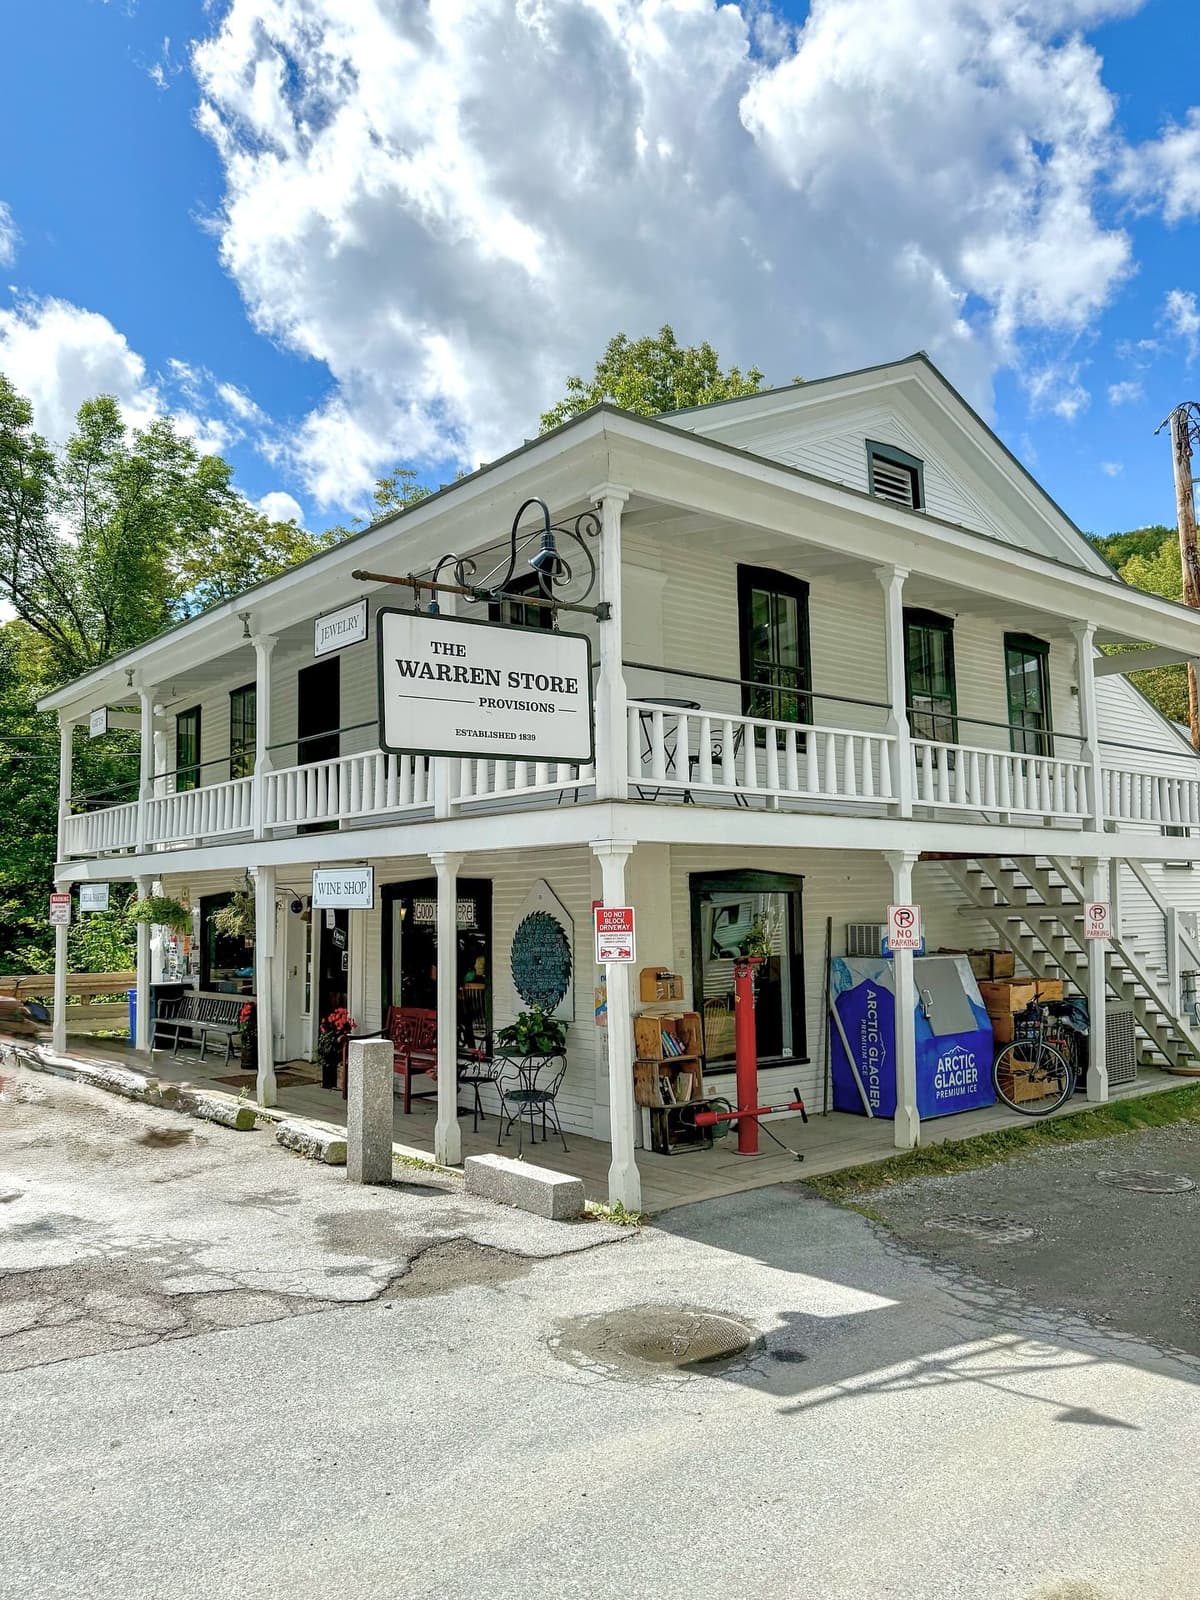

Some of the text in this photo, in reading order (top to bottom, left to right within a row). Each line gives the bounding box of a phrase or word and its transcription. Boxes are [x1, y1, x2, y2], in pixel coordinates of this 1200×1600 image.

[320, 614, 360, 645] JEWELRY
[430, 640, 467, 658] THE
[395, 659, 502, 687] WARREN
[507, 671, 578, 694] STORE
[479, 697, 555, 713] PROVISIONS
[455, 728, 536, 742] ESTABLISHED 1839
[318, 881, 367, 895] WINE SHOP
[416, 903, 434, 919] GOOD
[891, 938, 919, 947] PARKING
[896, 929, 912, 938] NO
[866, 989, 878, 1043] ARCTIC
[937, 1053, 976, 1073] ARCTIC
[868, 1047, 880, 1108] GLACIER
[934, 1068, 978, 1089] GLACIER
[936, 1084, 977, 1099] PREMIUM ICE
